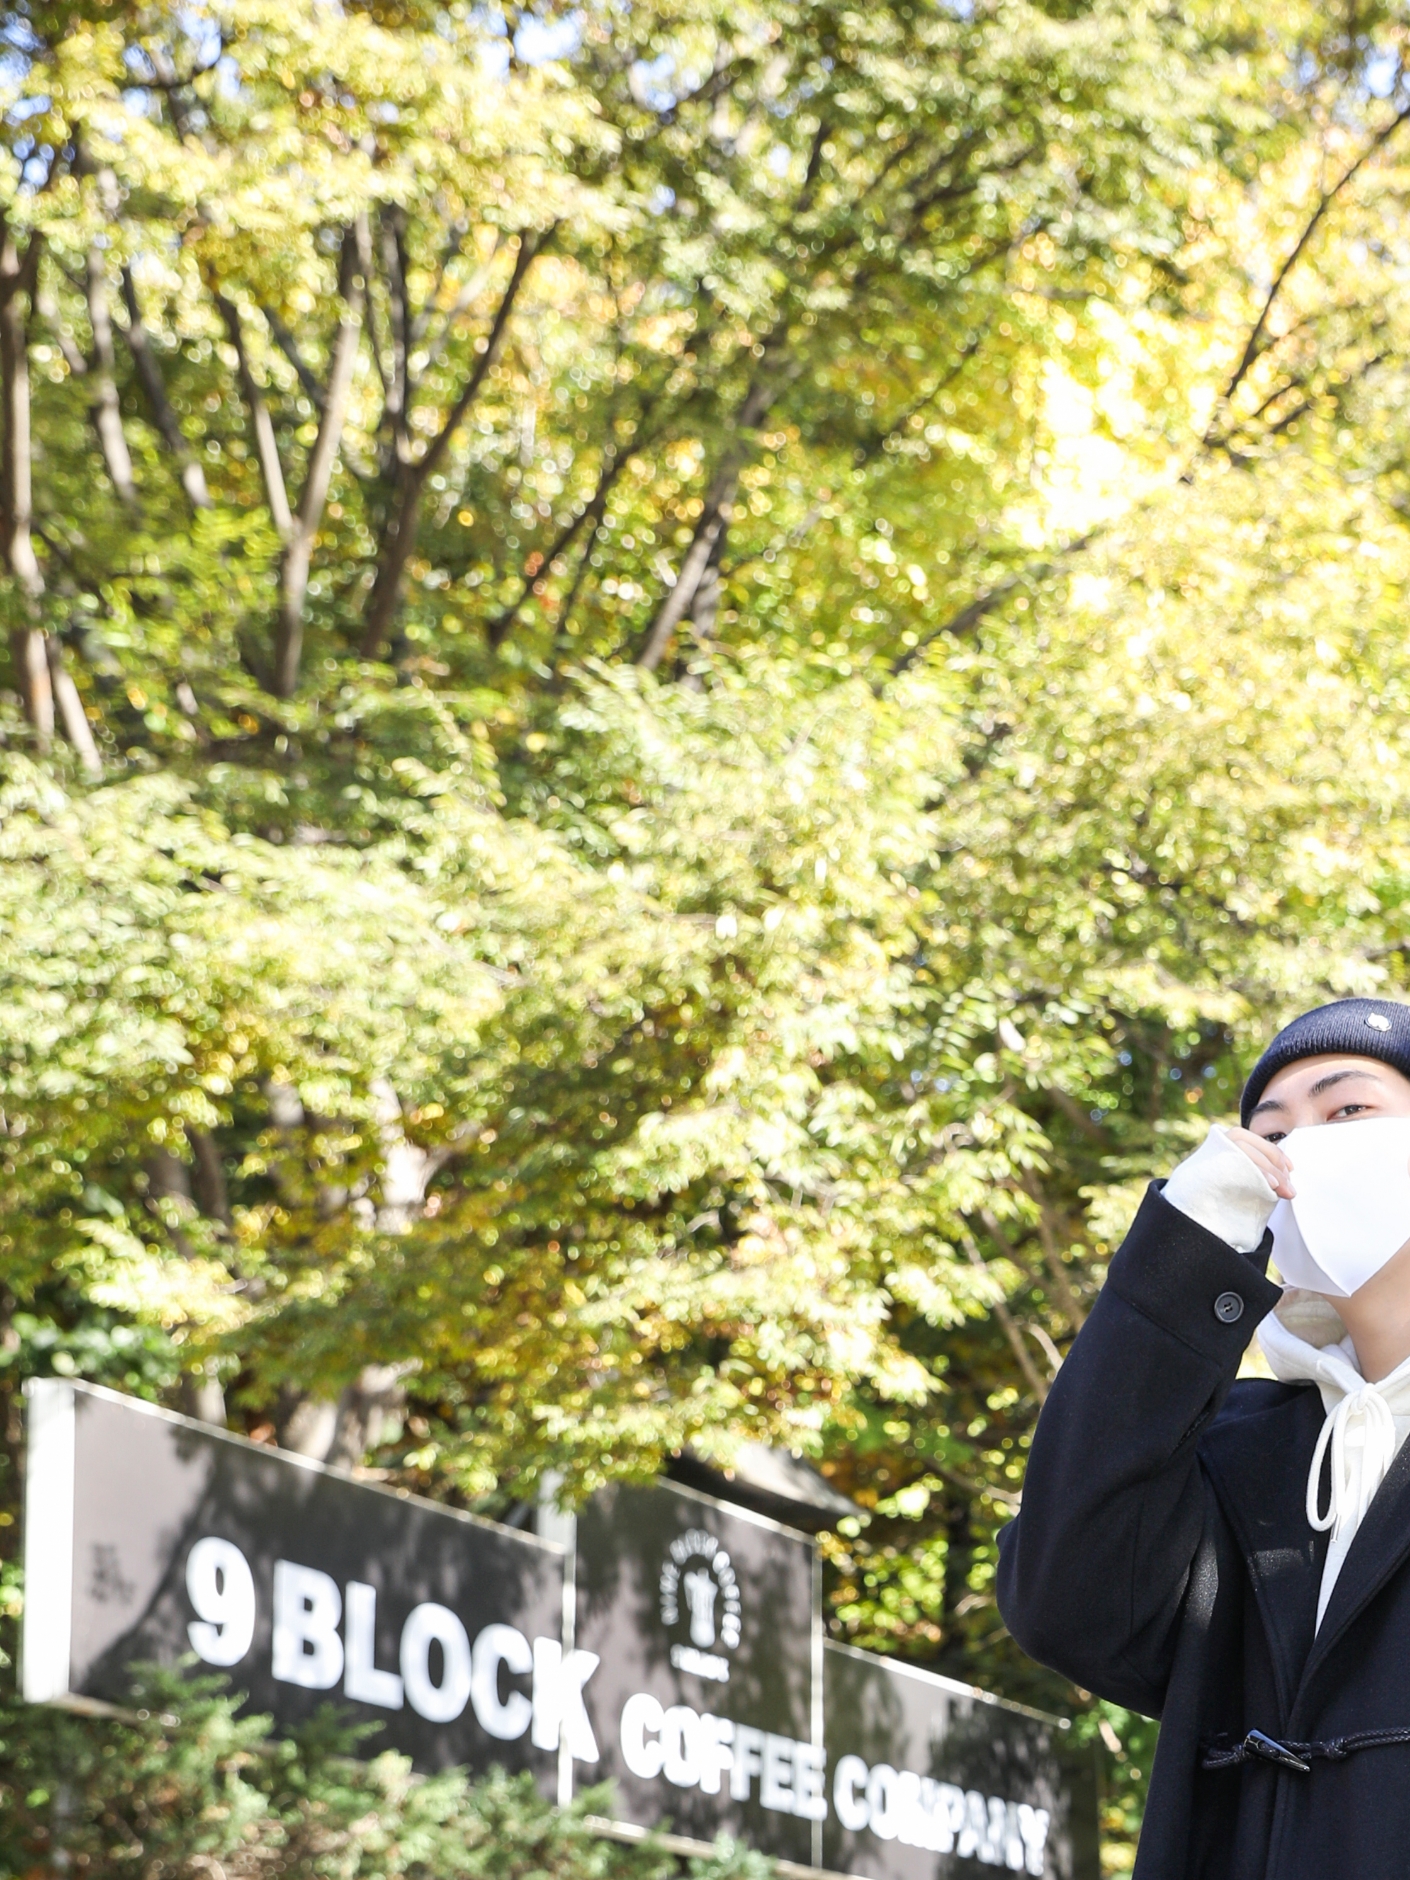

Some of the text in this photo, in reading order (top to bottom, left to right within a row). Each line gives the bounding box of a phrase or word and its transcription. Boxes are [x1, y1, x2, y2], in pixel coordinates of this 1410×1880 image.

[186, 1536, 256, 1667] 9
[271, 1558, 600, 1763] BLOCK
[620, 1692, 828, 1822] COFFEE
[833, 1754, 1050, 1877] COMPANY
